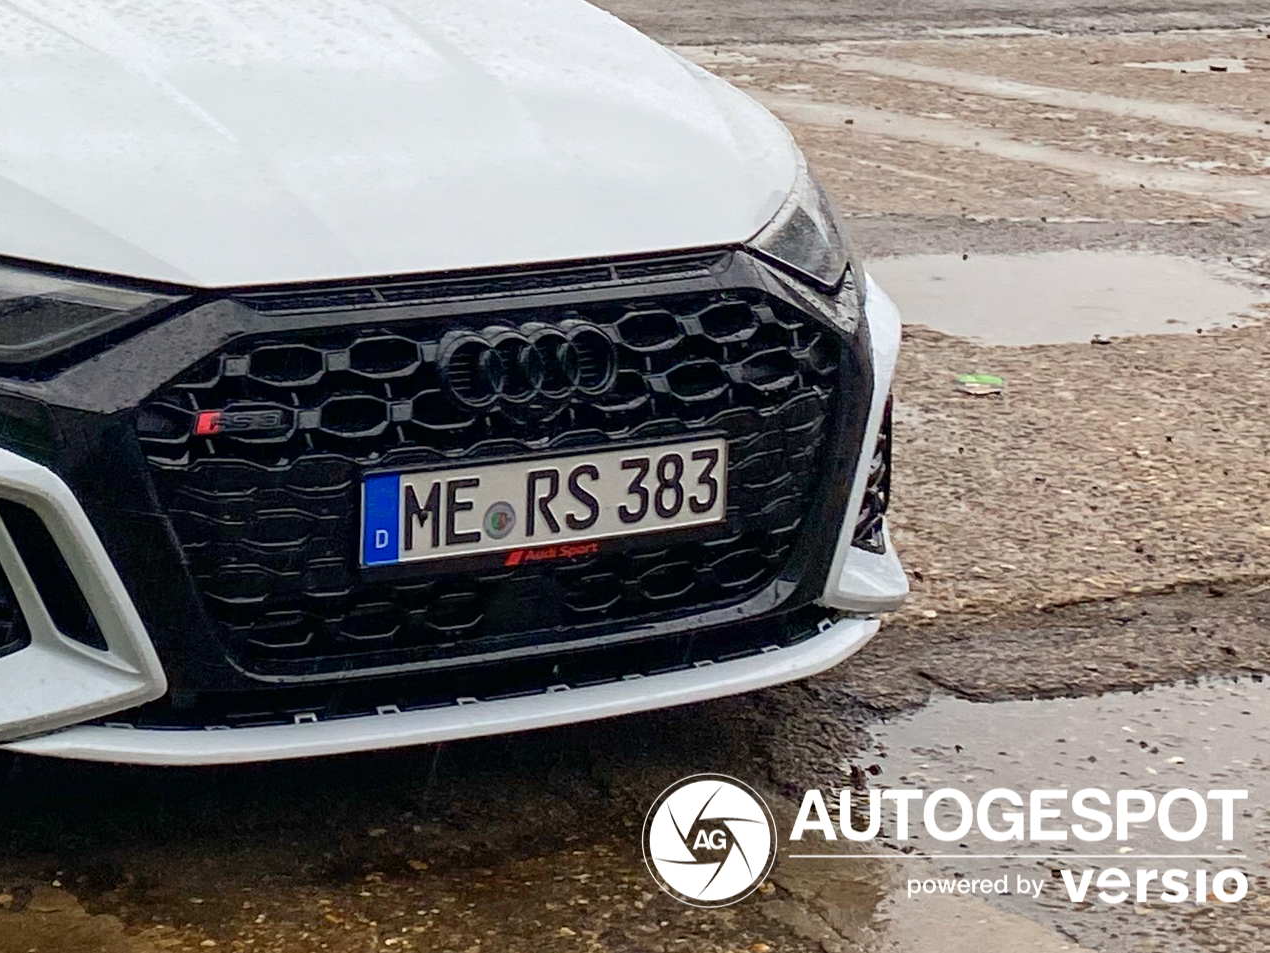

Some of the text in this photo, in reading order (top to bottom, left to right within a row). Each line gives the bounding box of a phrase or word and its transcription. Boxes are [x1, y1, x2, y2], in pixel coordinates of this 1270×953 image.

[403, 448, 719, 551] ME RS 383
[375, 529, 389, 550] D
[525, 542, 598, 560] Audi Sport
